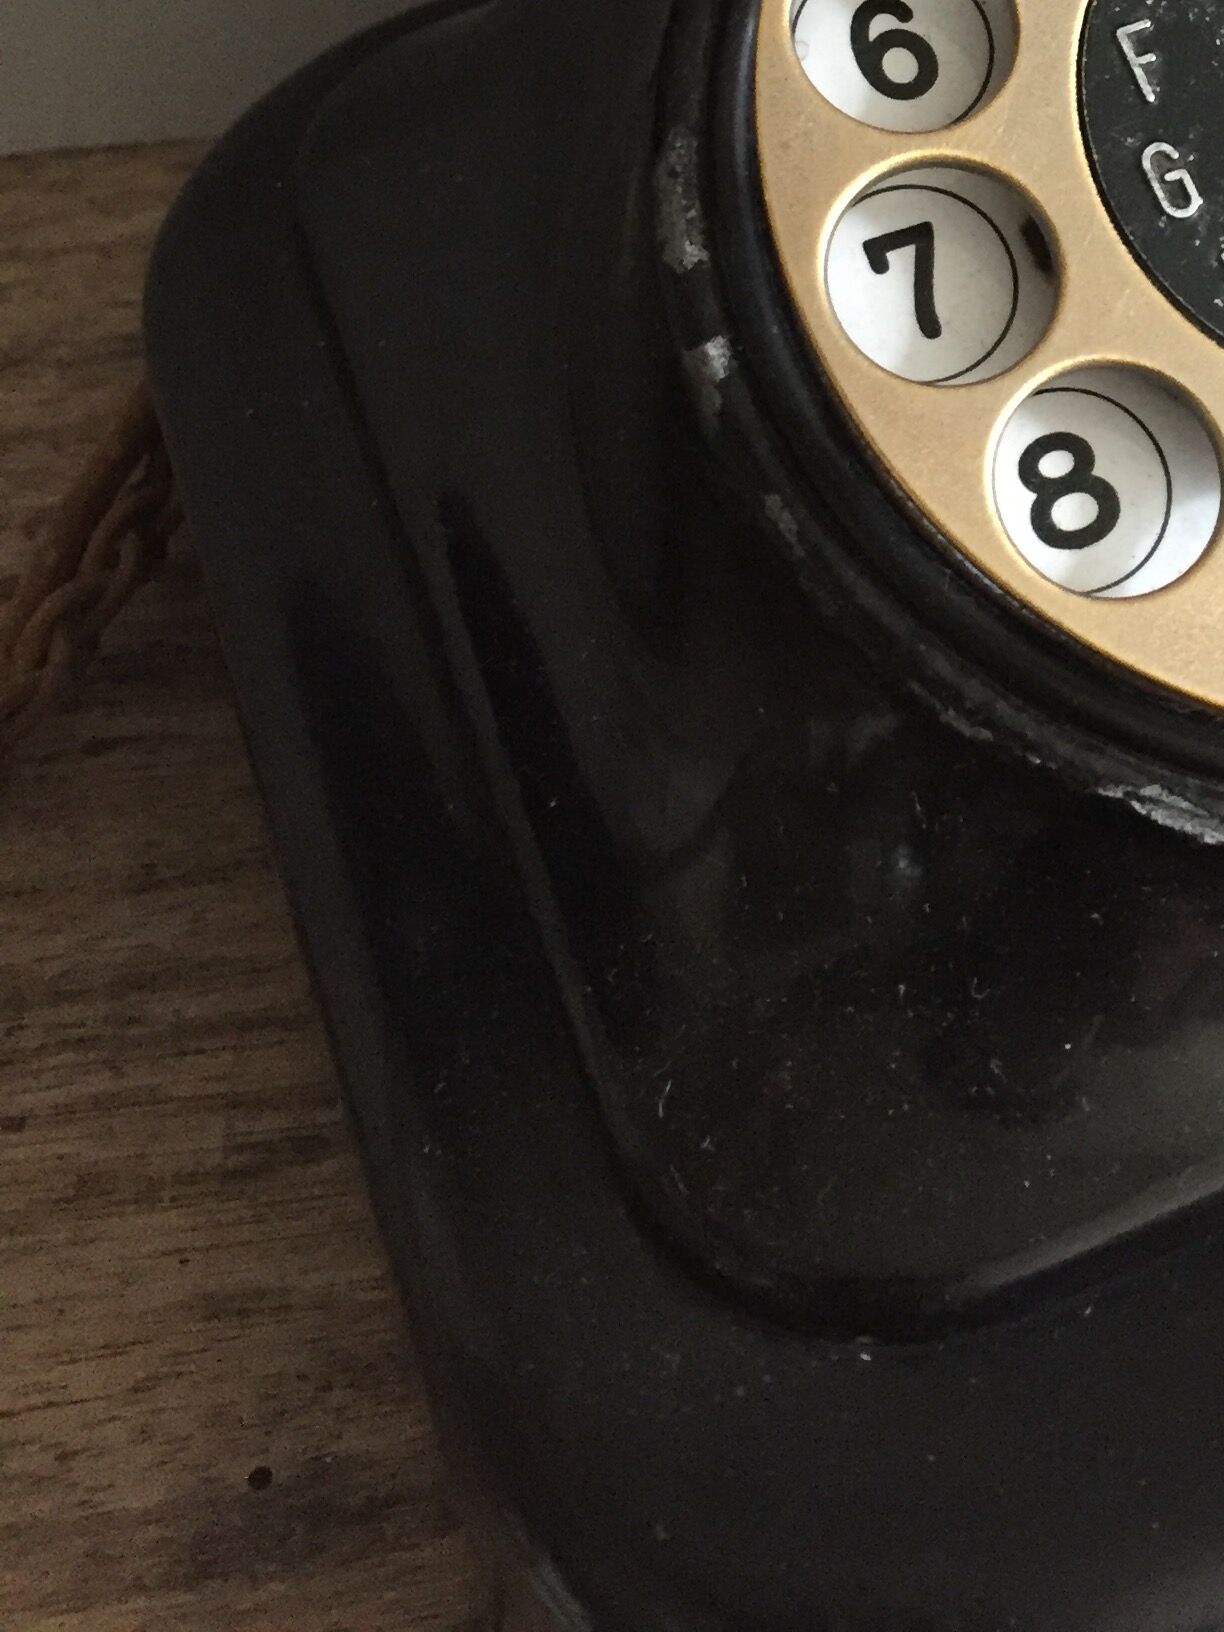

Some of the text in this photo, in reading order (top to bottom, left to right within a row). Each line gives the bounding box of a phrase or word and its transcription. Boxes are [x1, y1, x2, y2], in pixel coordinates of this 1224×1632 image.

[1116, 19, 1156, 103] F
[1141, 142, 1203, 218] G
[862, 221, 942, 339] 7
[1018, 431, 1121, 550] 8
